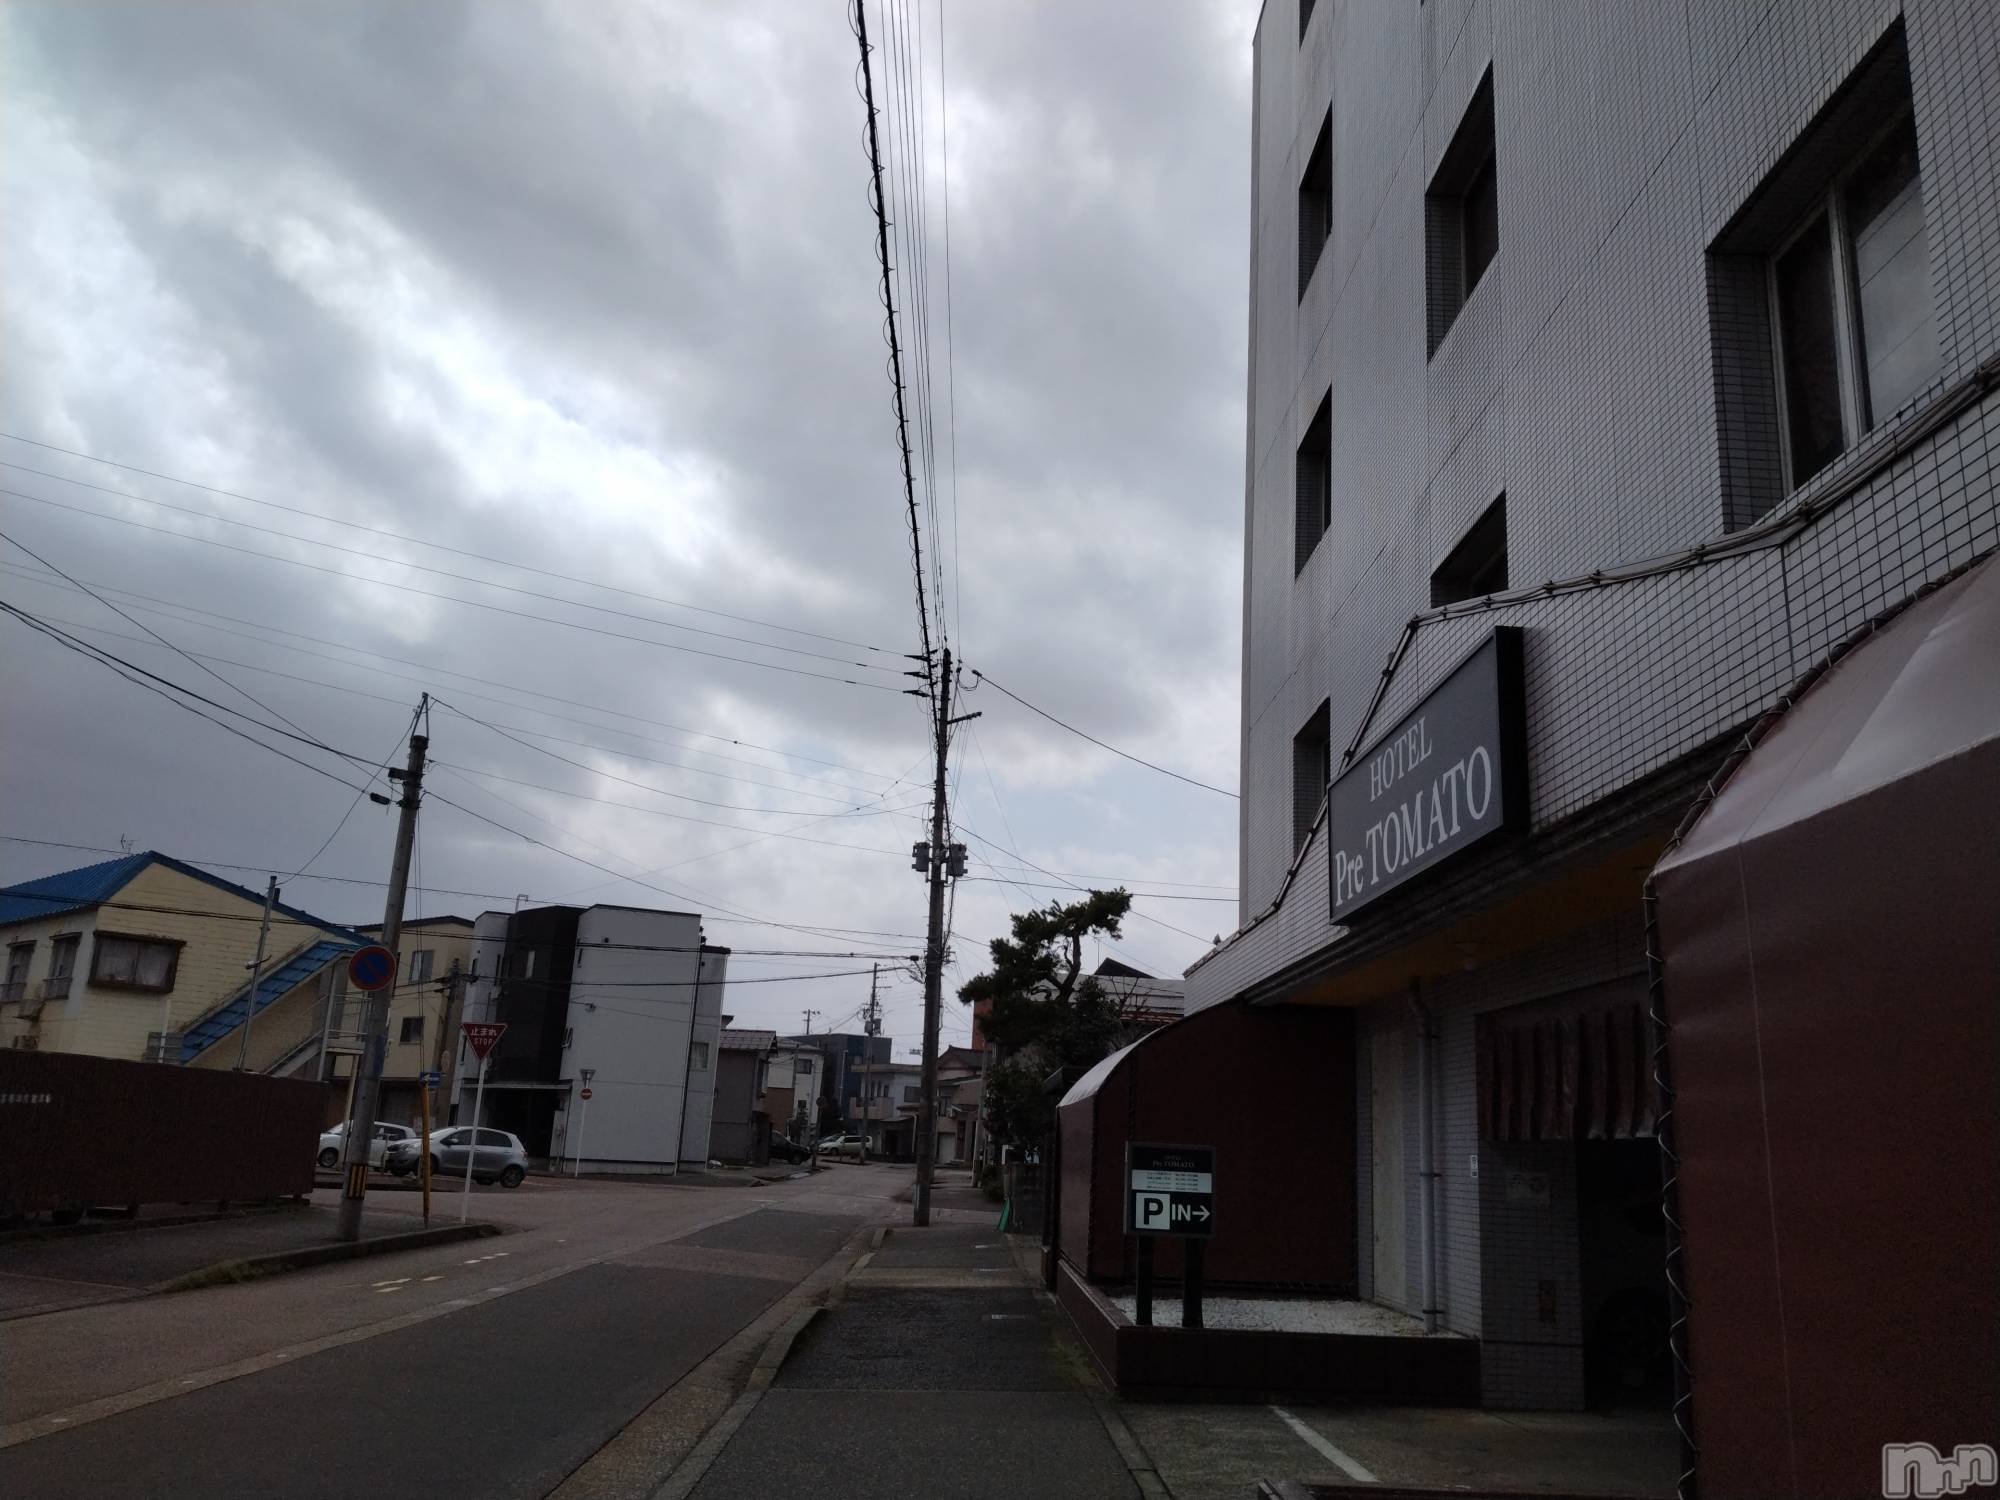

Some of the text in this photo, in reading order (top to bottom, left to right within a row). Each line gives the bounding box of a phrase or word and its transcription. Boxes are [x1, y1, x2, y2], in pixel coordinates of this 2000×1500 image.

[1369, 716, 1432, 802] HOTEL
[1335, 745, 1492, 907] Pre TOMATO
[470, 1026, 497, 1037] 止まれ
[474, 1037, 493, 1045] STOP
[1143, 1197, 1191, 1225] P IN
